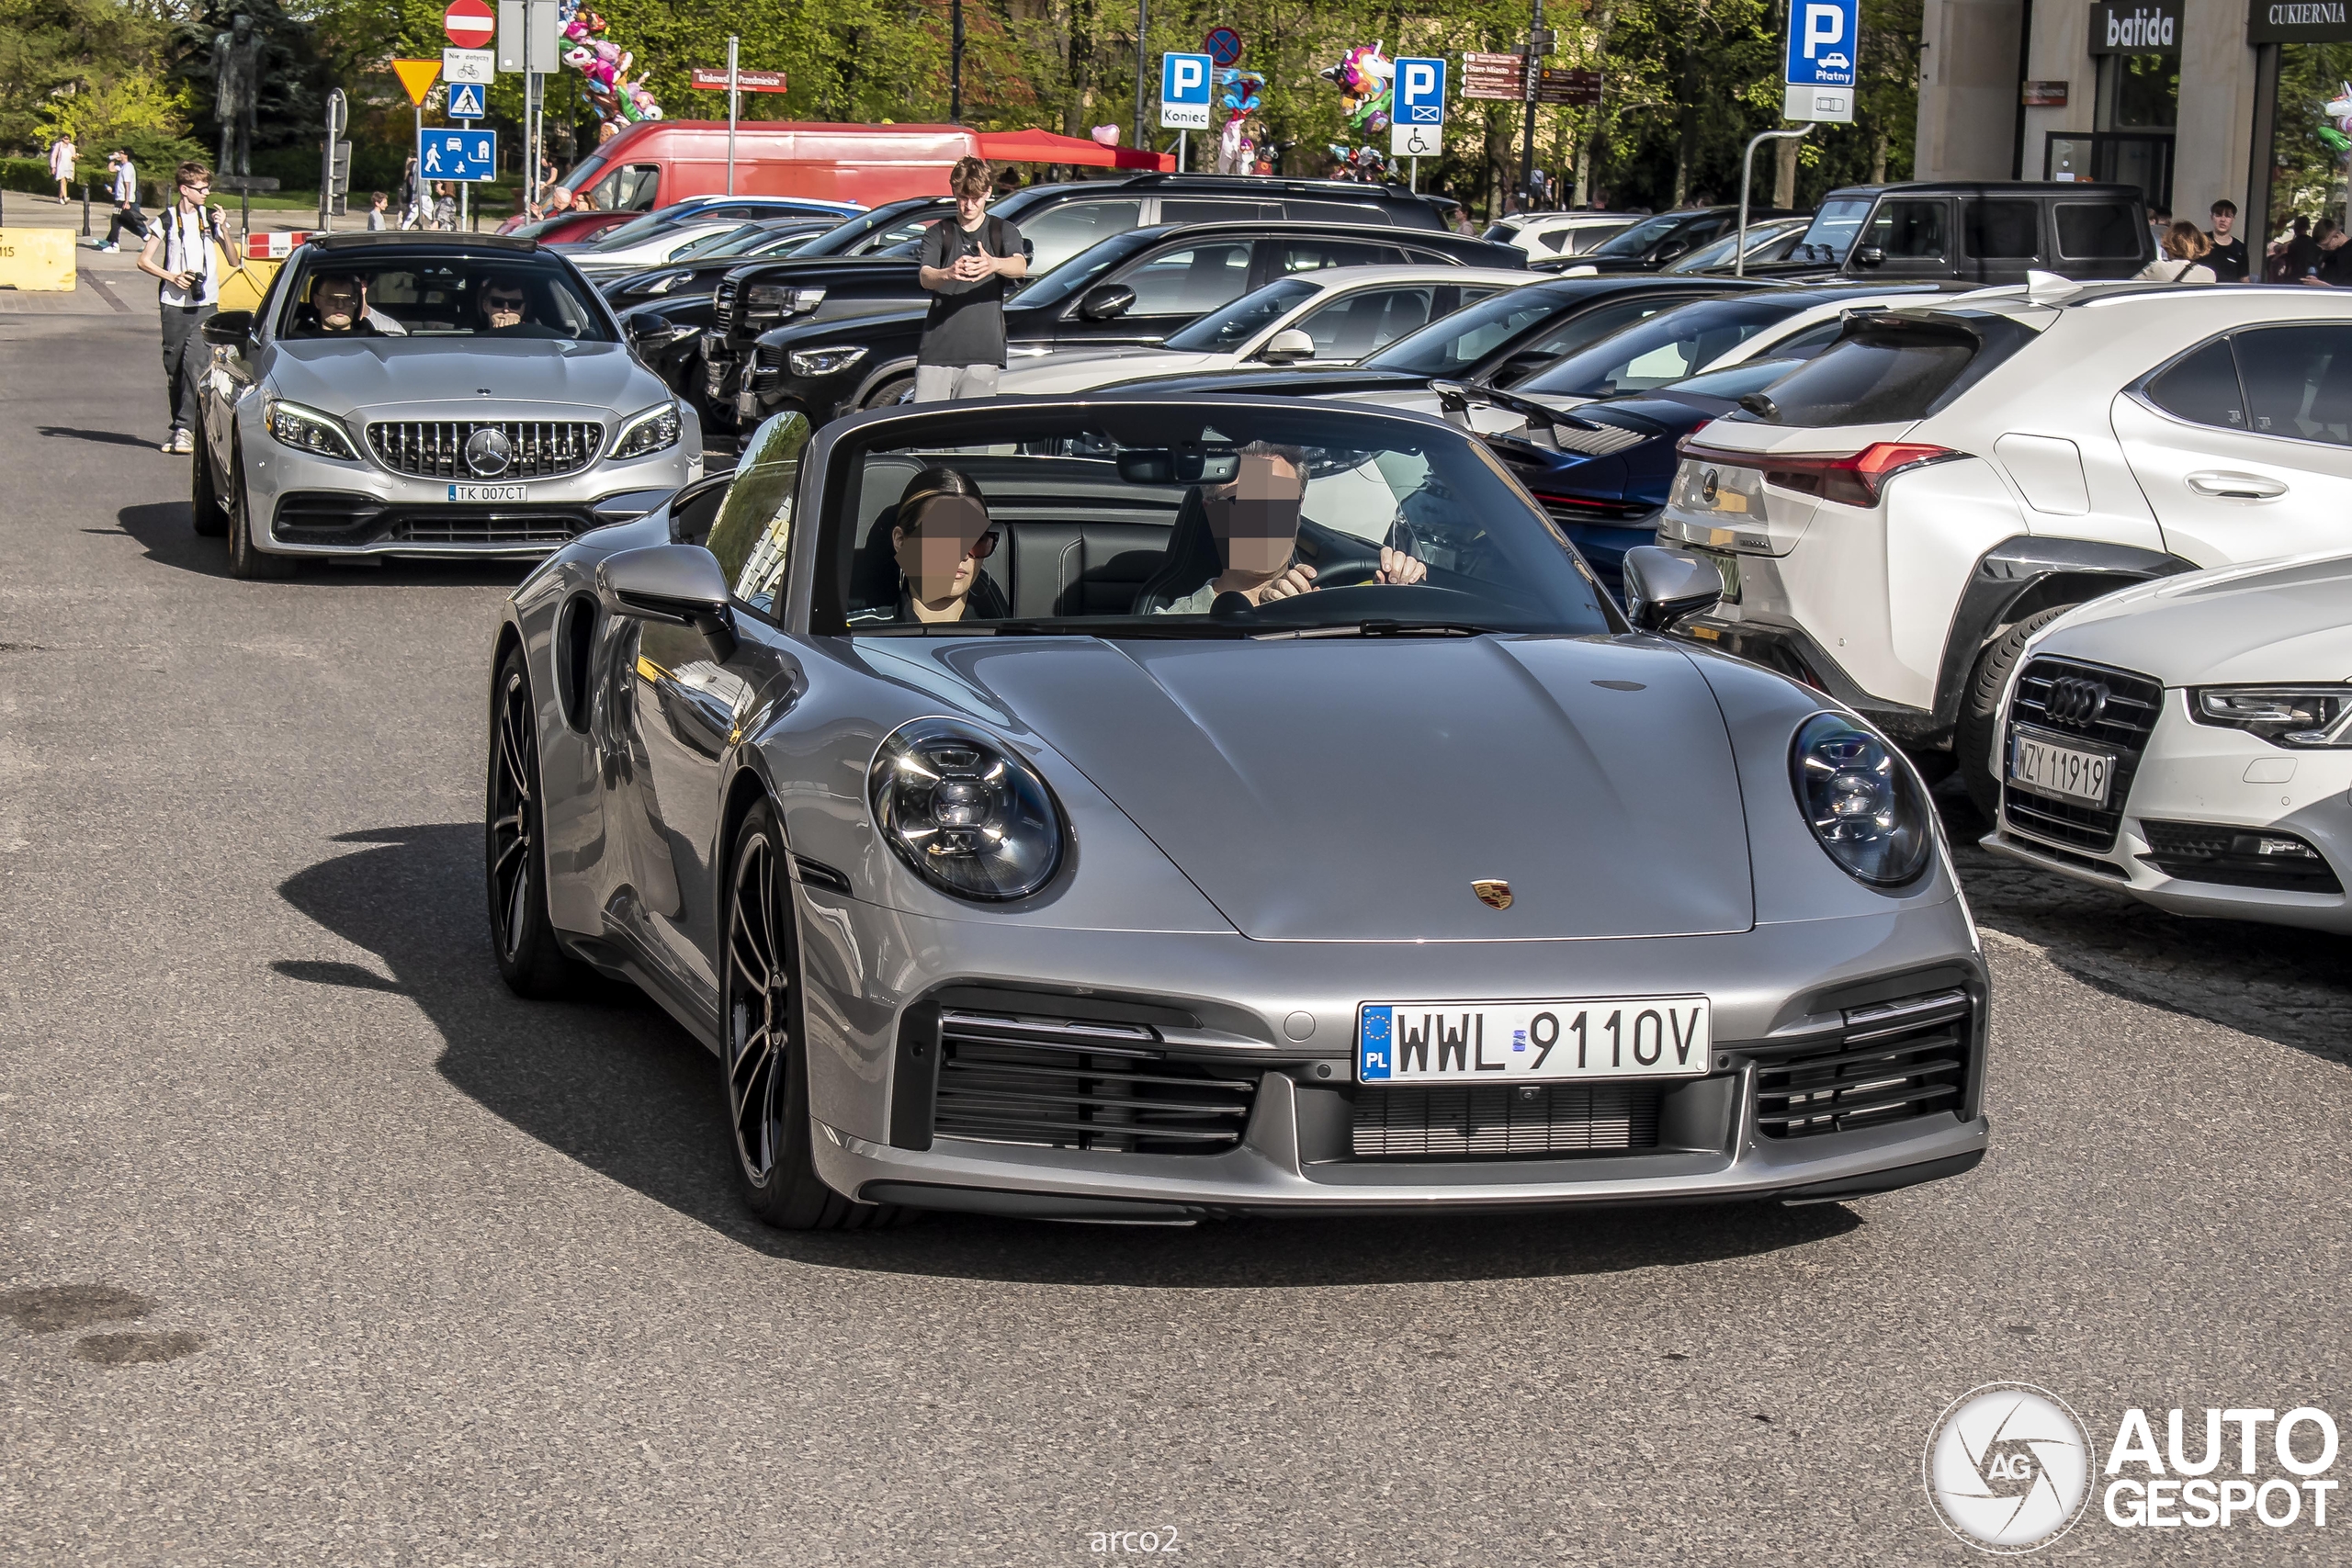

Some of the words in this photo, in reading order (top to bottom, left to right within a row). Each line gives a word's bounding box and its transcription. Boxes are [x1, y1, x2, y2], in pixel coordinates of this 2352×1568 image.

[2268, 3, 2346, 25] CUKIERNIA
[1804, 3, 1844, 59] P
[2107, 7, 2175, 47] batida
[465, 54, 490, 62] dotyczy
[1173, 59, 1203, 98] P
[1467, 64, 1487, 73] Stare
[1486, 65, 1510, 75] Miasto
[1815, 70, 1851, 85] Płatny
[1404, 63, 1435, 106] P
[1164, 109, 1206, 122] Koniec
[458, 487, 477, 500] TK
[481, 487, 525, 500] 007CT
[2018, 741, 2045, 783] WZY
[2051, 750, 2104, 796] 11919
[1397, 1013, 1506, 1072] WWL
[1529, 1007, 1701, 1070] 9110V
[1365, 1052, 1388, 1069] PL
